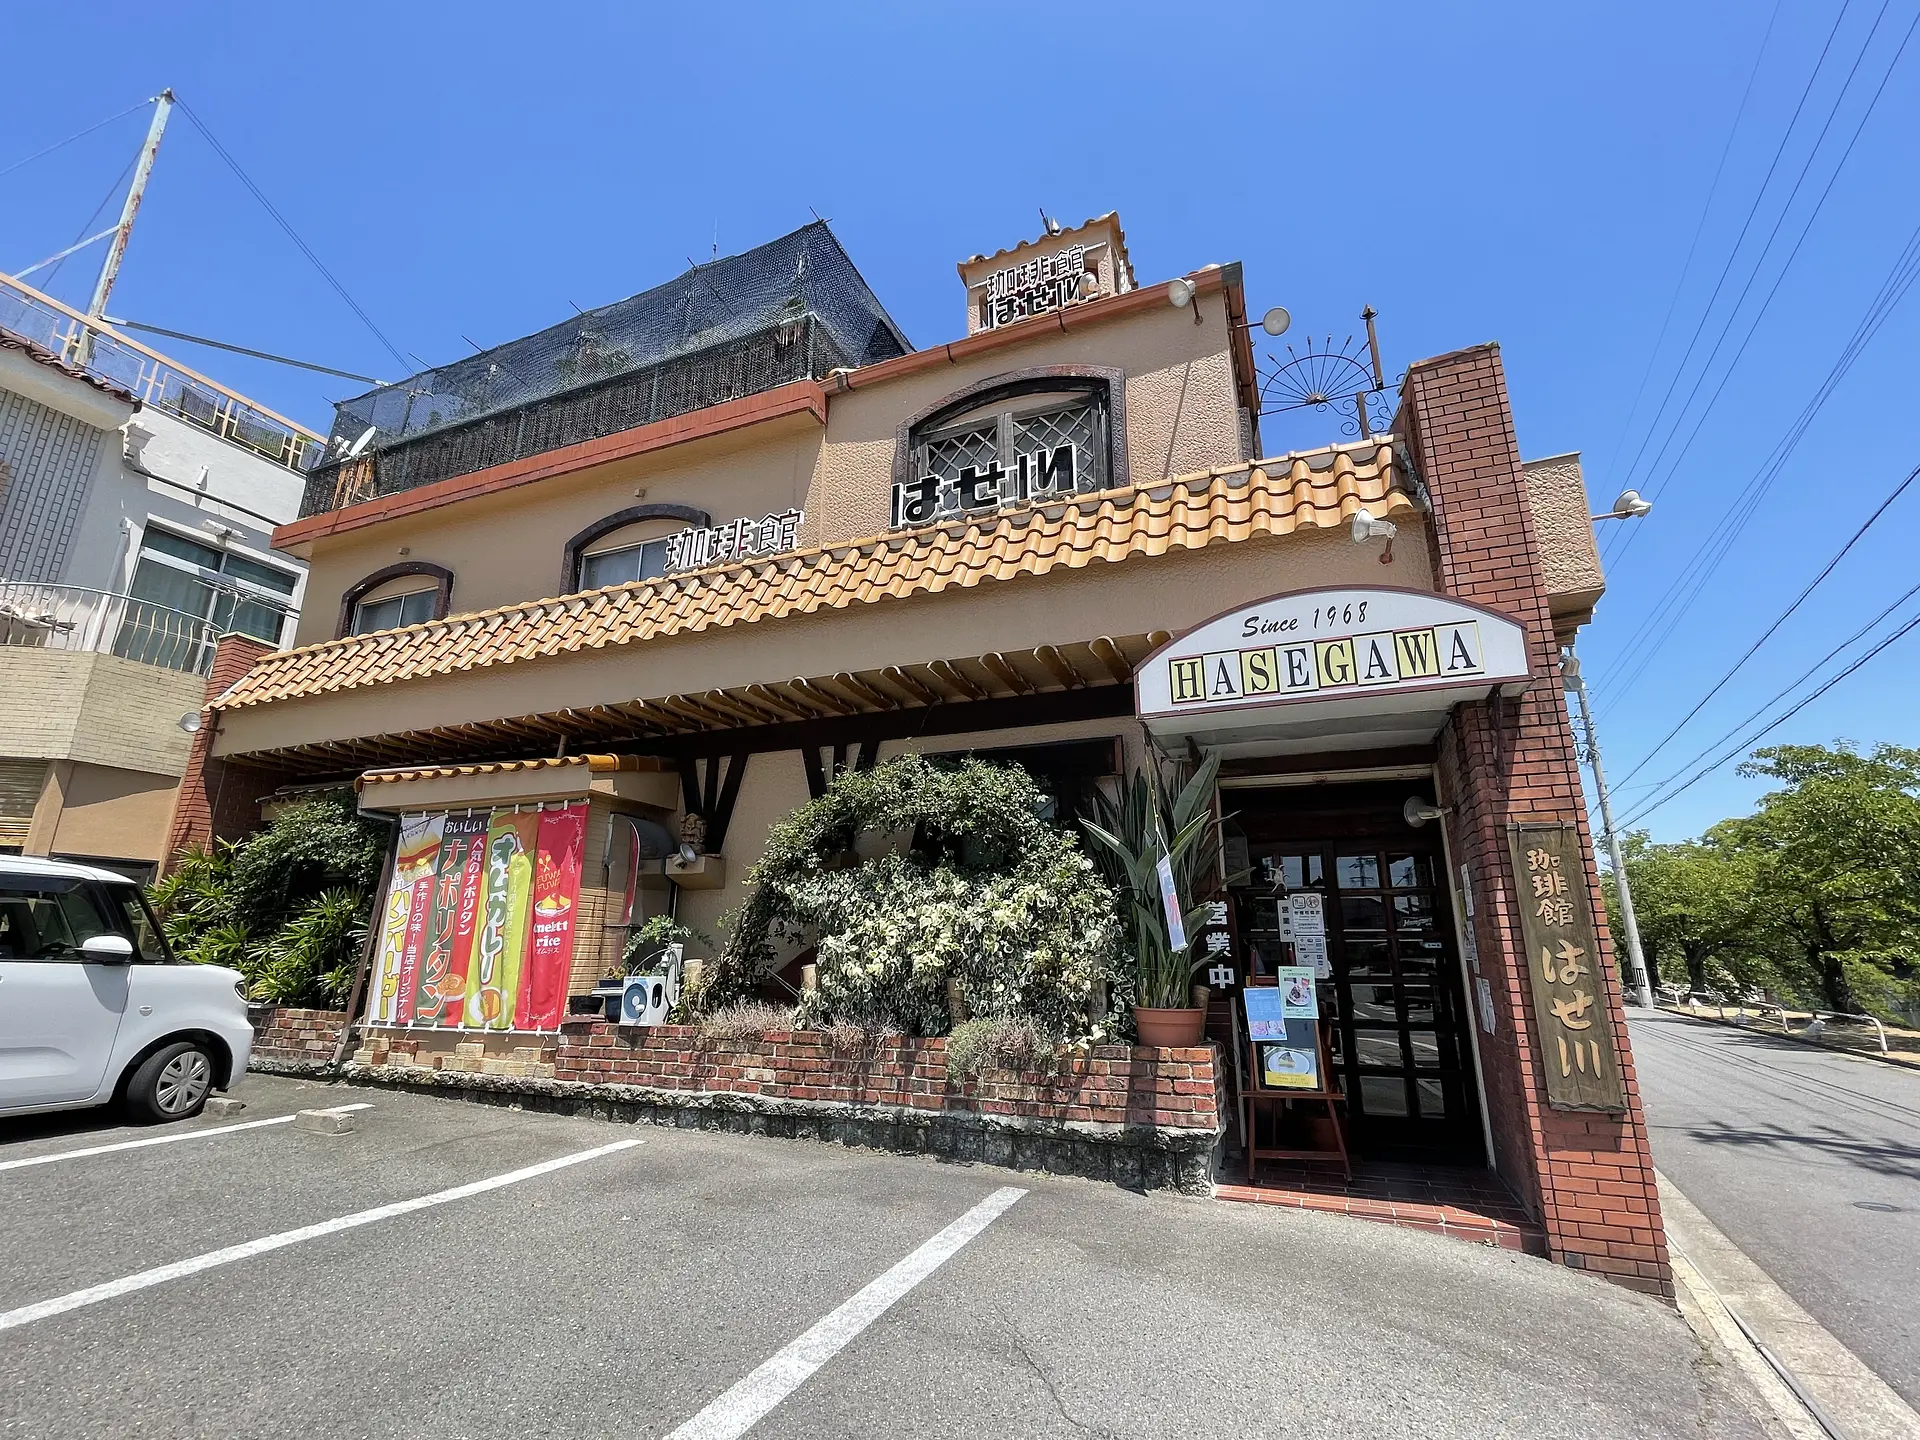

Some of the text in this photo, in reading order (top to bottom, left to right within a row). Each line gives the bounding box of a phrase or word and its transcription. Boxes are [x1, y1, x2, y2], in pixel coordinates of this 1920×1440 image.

[986, 244, 1085, 300] 珈琲館
[663, 509, 805, 570] 珈琲館
[1175, 627, 1478, 700] HASEGAWA
[1242, 601, 1368, 638] Since 1968
[417, 838, 467, 1020] ナポリタン
[458, 837, 485, 936] 人気のナポリタン
[481, 833, 516, 984] オムカレー
[380, 889, 410, 1020] ハンバーガー
[536, 935, 561, 947] rice
[1206, 901, 1235, 989] 営業中
[1526, 847, 1601, 1080] 珈琲館 はせ川
